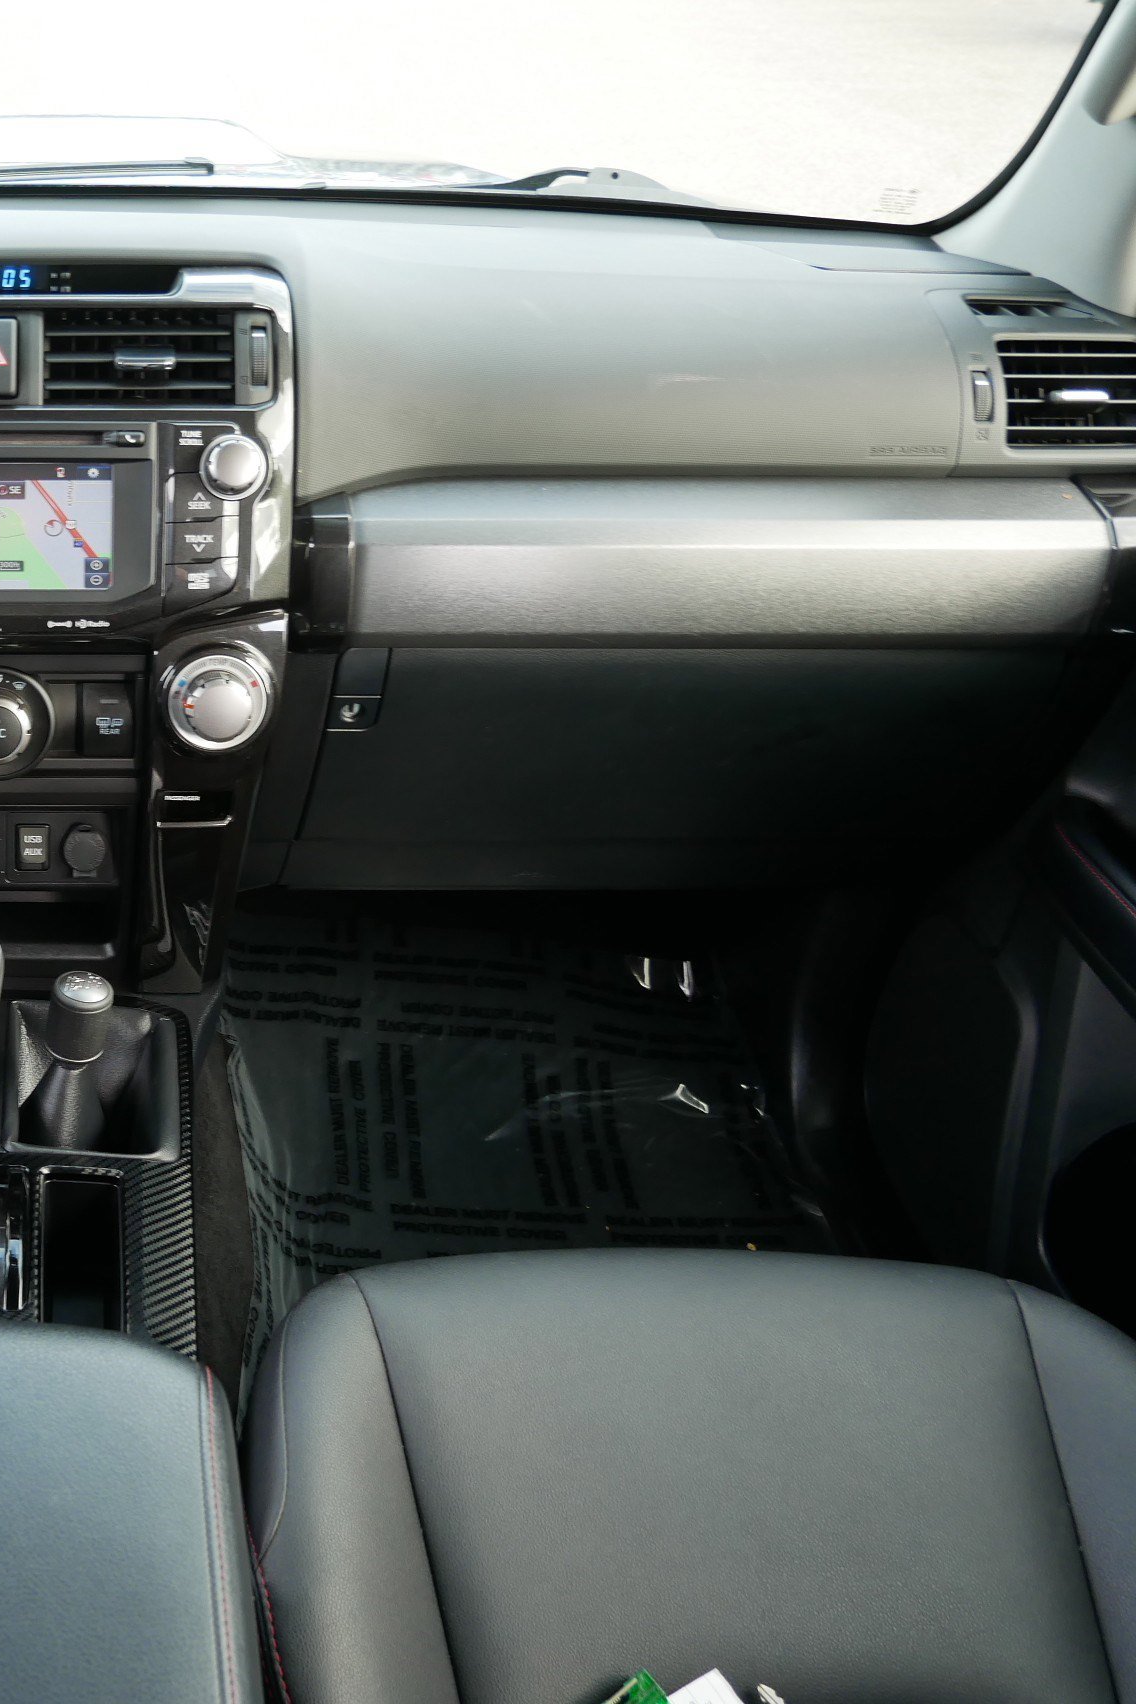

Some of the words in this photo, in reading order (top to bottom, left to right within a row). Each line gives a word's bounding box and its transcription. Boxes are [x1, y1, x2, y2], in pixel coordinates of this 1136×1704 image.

[8, 485, 23, 494] SE
[187, 501, 212, 510] SEEK
[184, 535, 214, 543] TRACK
[23, 835, 43, 843] USB
[23, 848, 43, 856] AUX
